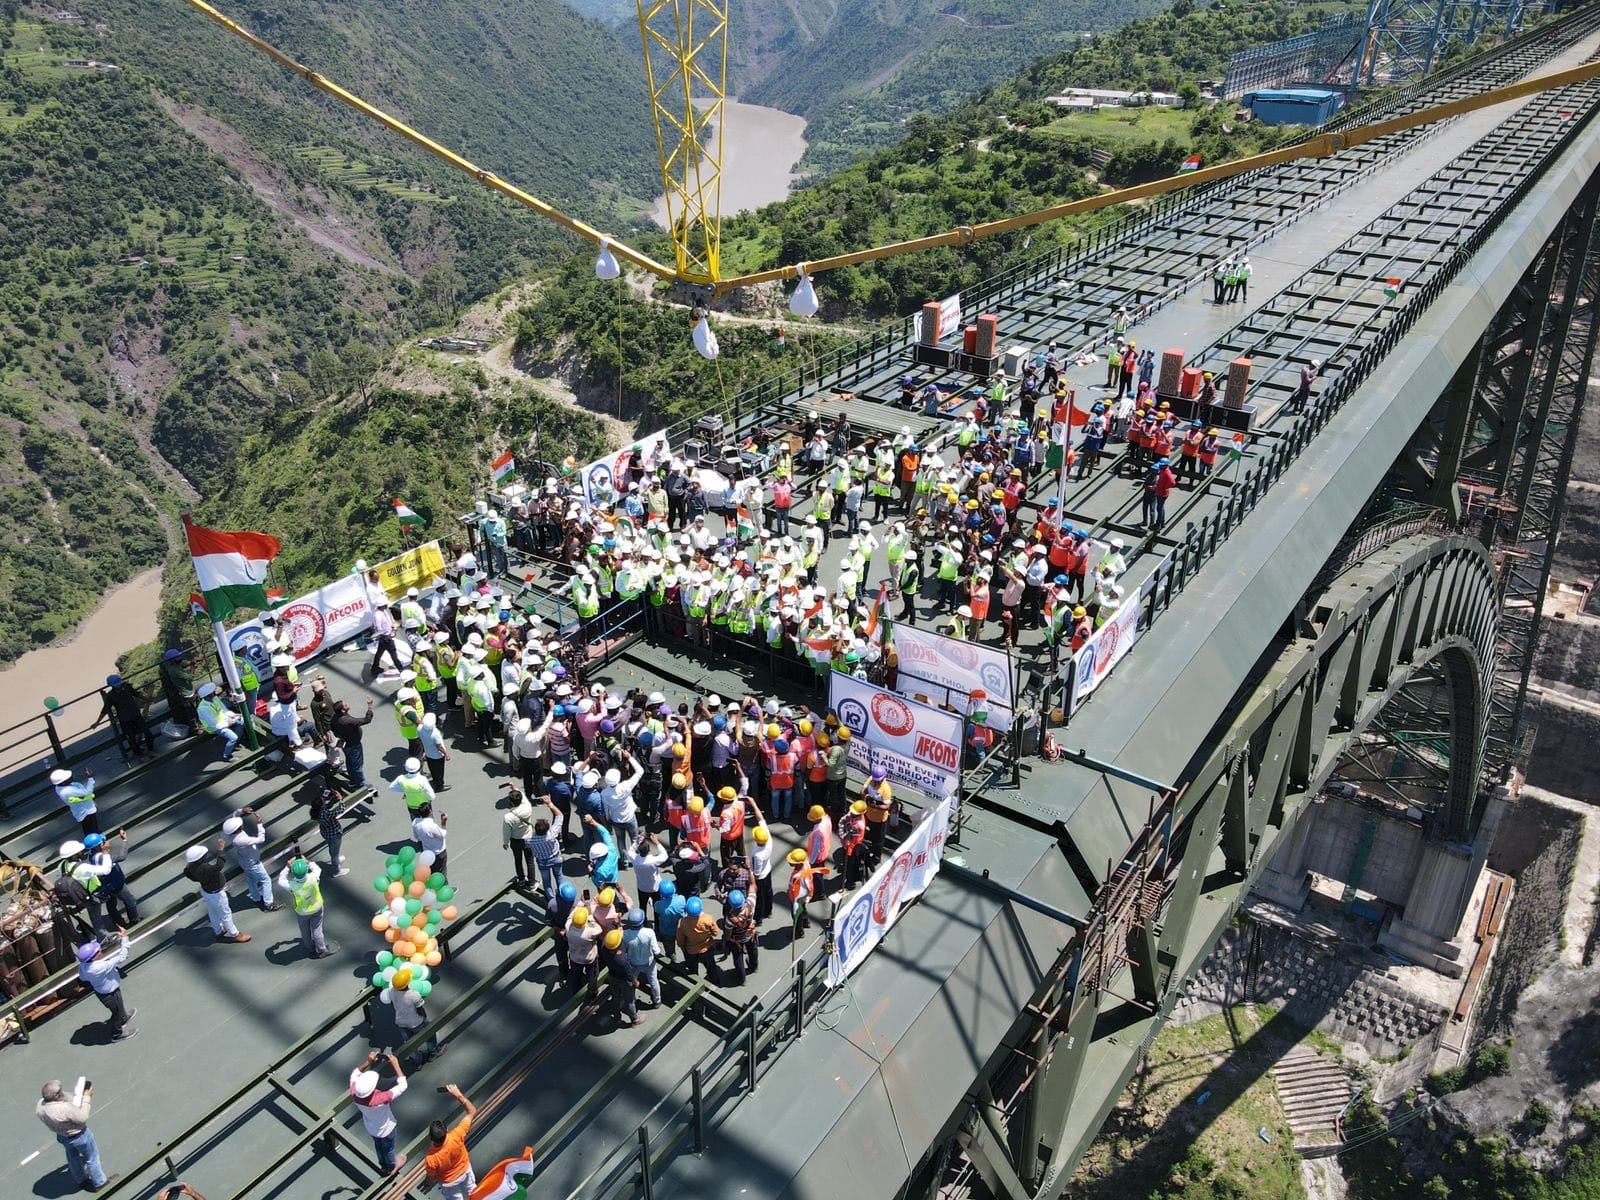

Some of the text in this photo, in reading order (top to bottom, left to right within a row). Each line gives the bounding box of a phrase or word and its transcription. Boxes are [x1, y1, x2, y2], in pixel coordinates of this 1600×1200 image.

[327, 599, 364, 624] AFCONS
[850, 740, 880, 758] OLDEN
[882, 754, 912, 769] JOINT
[915, 766, 947, 783] EVENT
[853, 748, 895, 770] CHENAB
[898, 766, 937, 788] BRIDGE
[915, 736, 958, 769] AFCONS
